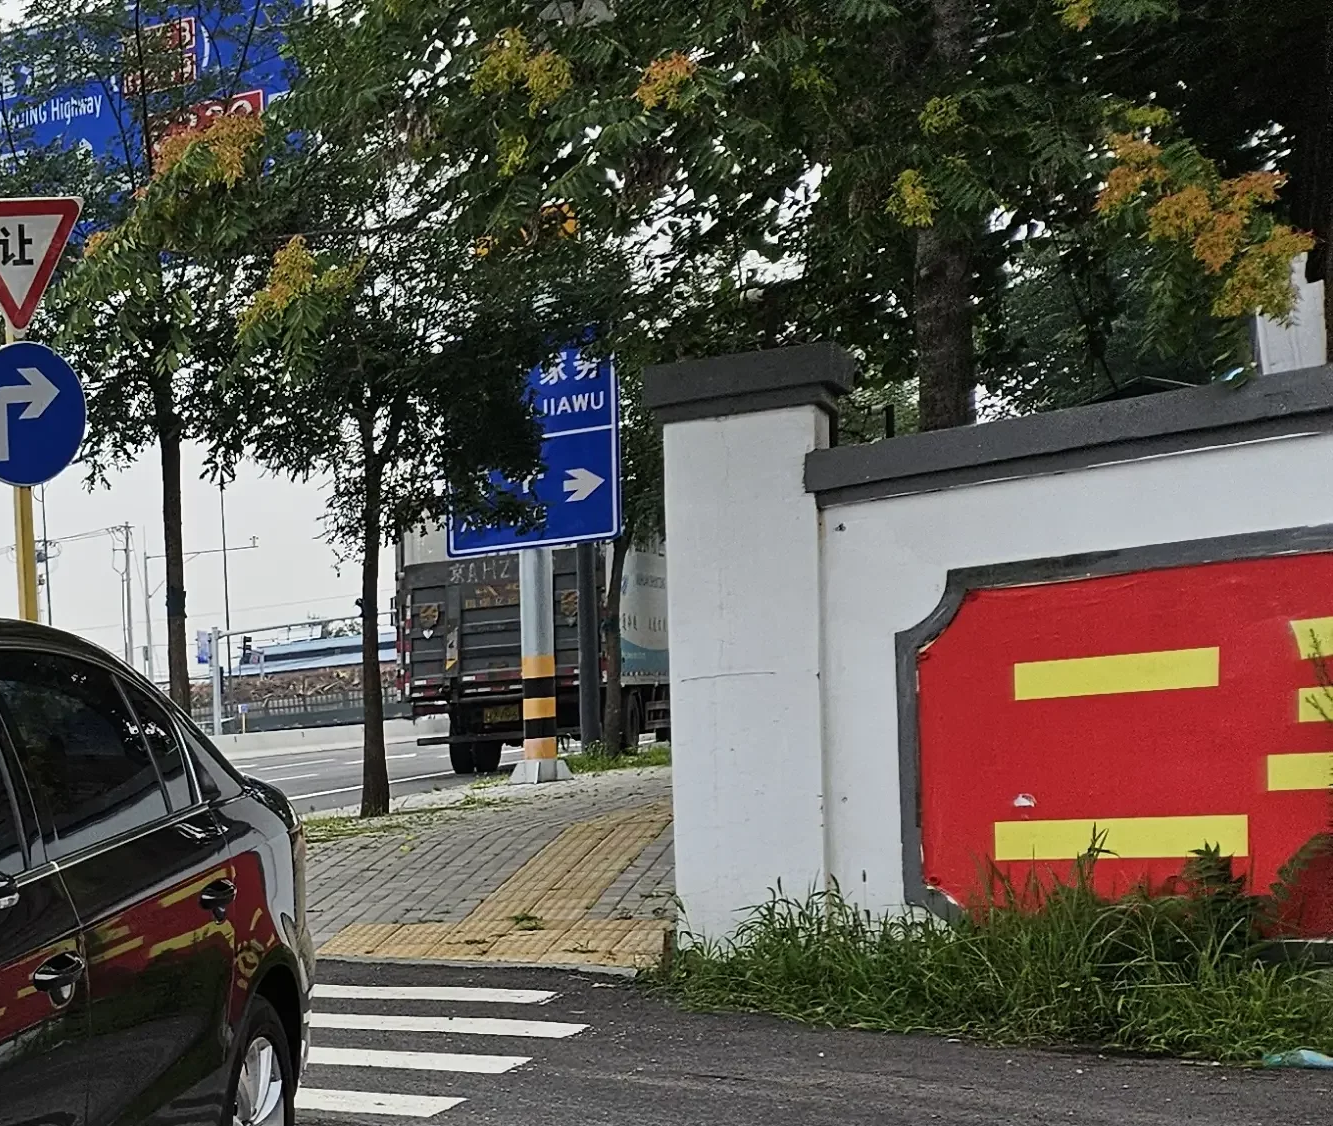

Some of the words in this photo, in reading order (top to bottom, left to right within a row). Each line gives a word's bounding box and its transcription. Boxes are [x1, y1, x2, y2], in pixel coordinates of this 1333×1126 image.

[50, 94, 103, 126] Highway
[536, 390, 605, 417] JIAWU
[449, 557, 518, 583] 京AHZ
